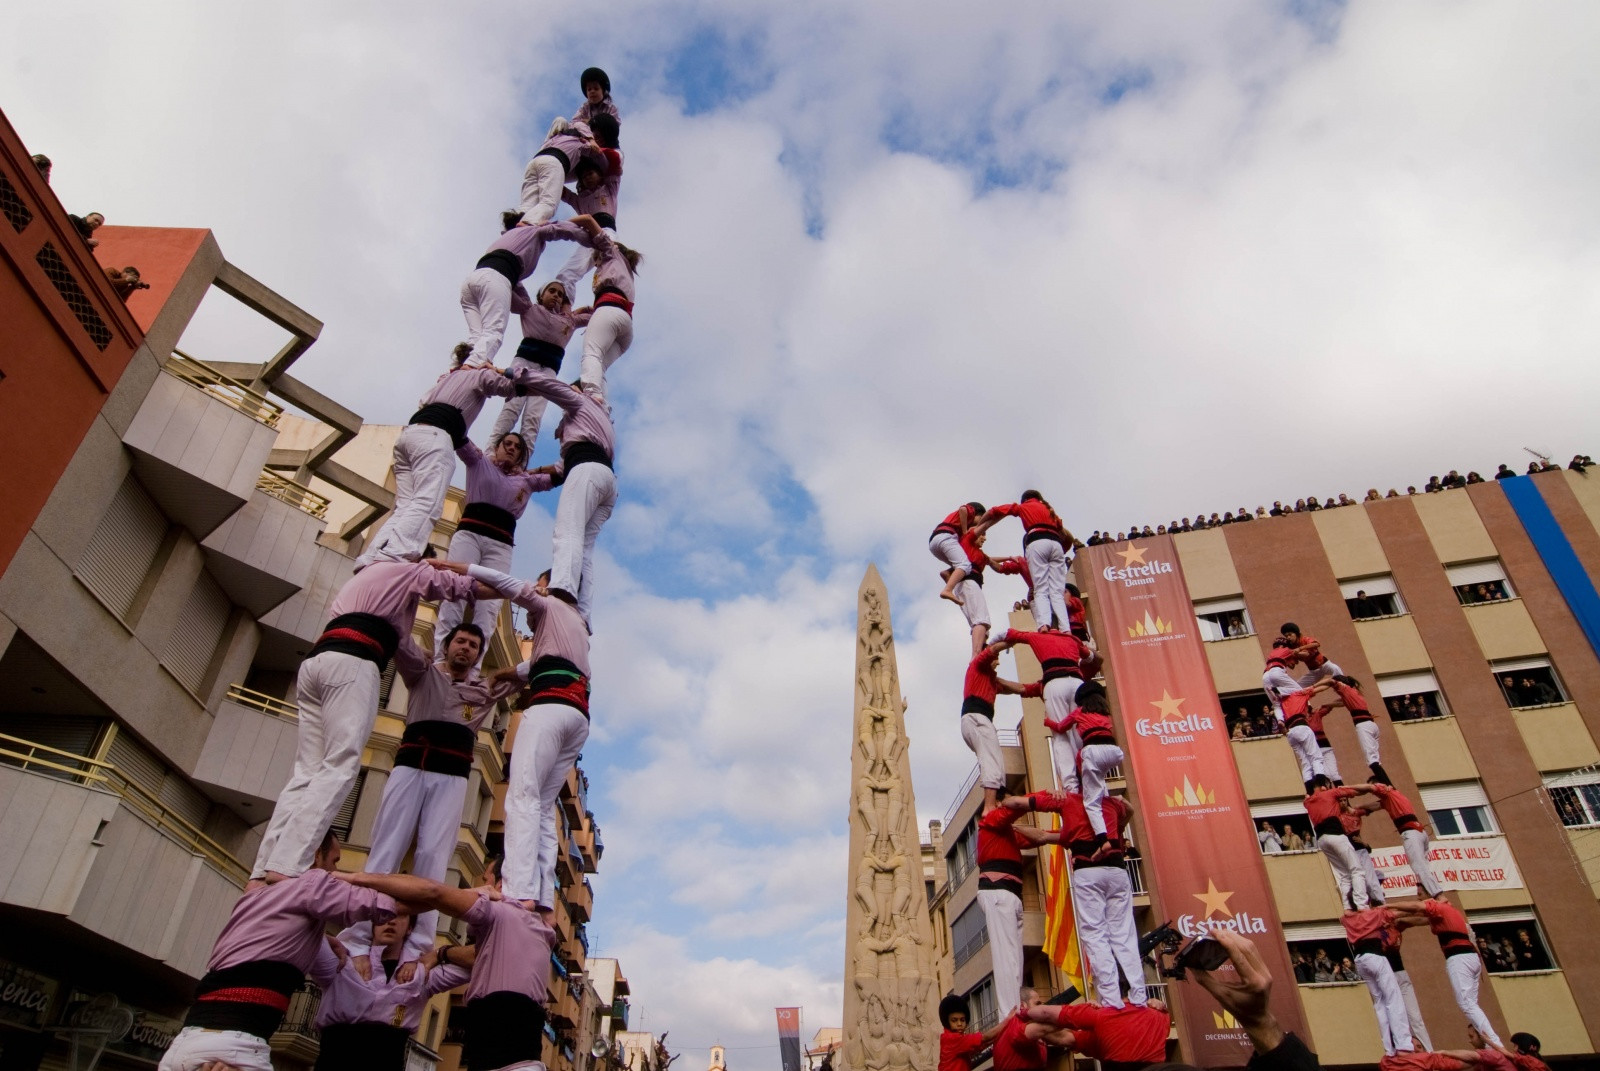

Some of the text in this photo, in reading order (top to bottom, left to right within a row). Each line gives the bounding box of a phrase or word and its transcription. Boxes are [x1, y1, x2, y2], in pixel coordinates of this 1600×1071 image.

[1103, 560, 1172, 582] Estrella
[1125, 577, 1155, 587] Damm
[1135, 714, 1214, 737] Estrella
[1160, 734, 1194, 745] Damm
[1167, 754, 1197, 762] PATROCINA
[1157, 810, 1190, 818] DECENNALS
[1451, 848, 1463, 860] DE
[1464, 847, 1491, 860] VALLS
[1461, 868, 1506, 882] CASTELLER
[1177, 912, 1268, 939] Estrella
[1205, 1033, 1242, 1041] DECENNALS
